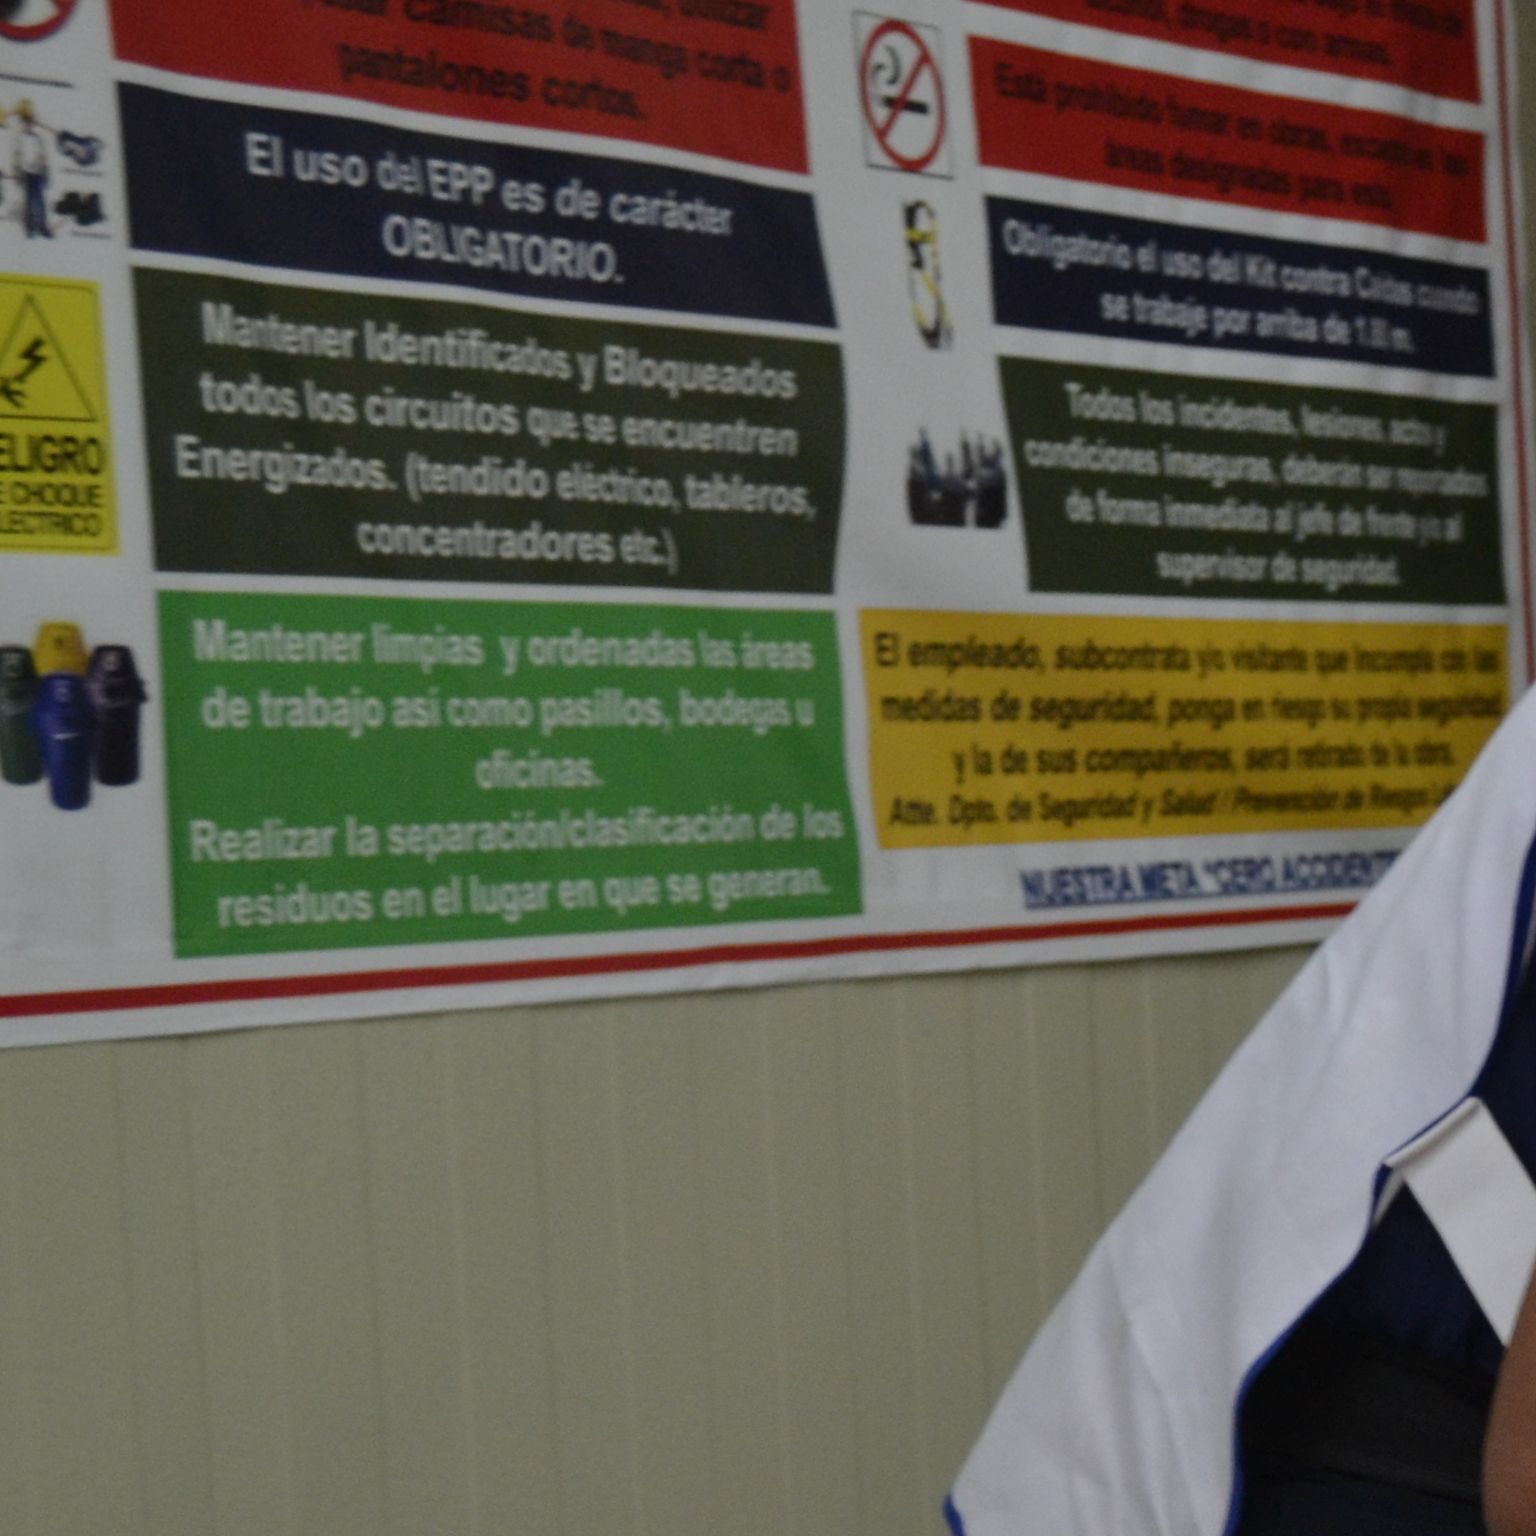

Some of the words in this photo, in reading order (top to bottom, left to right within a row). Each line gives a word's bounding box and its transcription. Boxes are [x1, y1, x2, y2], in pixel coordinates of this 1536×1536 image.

[336, 43, 531, 103] pantalones
[245, 131, 285, 178] El
[293, 149, 369, 188] uso
[376, 152, 425, 196] del
[426, 157, 496, 206] EPP
[501, 179, 547, 214] es
[554, 177, 600, 221] de
[608, 189, 735, 236] carácter
[381, 213, 626, 284] OBLIGATORIO.
[1001, 217, 1133, 270] Obligatorio
[201, 300, 357, 358] Mantener
[362, 319, 573, 381] Identificados
[577, 351, 599, 392] y
[603, 344, 799, 399] Bloqueados
[199, 371, 300, 419] todos
[304, 379, 358, 423] los
[363, 385, 521, 437] circuitos
[526, 405, 579, 447] que
[581, 411, 617, 445] se
[621, 417, 799, 456] encuentren
[1064, 381, 1137, 423] Todos
[0, 432, 106, 475] ELIGRO
[174, 433, 398, 495] Energizados.
[405, 451, 550, 503] (tendido
[683, 473, 818, 522] tableros,
[1022, 436, 1160, 477] condiciones
[356, 520, 616, 563] concentradores
[192, 618, 365, 664] Mantener
[370, 622, 485, 675] limpias
[499, 635, 520, 677] y
[527, 626, 697, 668] ordenadas
[698, 628, 738, 668] las
[740, 630, 816, 671] áreas
[875, 631, 899, 668] El
[907, 634, 1045, 677] empleado,
[202, 685, 251, 729] de
[257, 686, 385, 739] trabajo
[446, 696, 534, 728] como
[540, 687, 673, 736] pasillos,
[677, 687, 792, 736] bodegas
[990, 689, 1022, 723] de
[474, 747, 605, 790] oficinas.
[189, 817, 337, 864] Realizar
[346, 814, 380, 857] la
[758, 802, 798, 841] de
[802, 801, 846, 840] los
[216, 880, 375, 929] residuos
[381, 886, 427, 919] en
[431, 875, 465, 917] el
[468, 871, 551, 924] lugar
[557, 877, 599, 910] en
[603, 875, 660, 917] que
[664, 872, 703, 905] se
[706, 865, 832, 912] generan.
[1020, 863, 1133, 911] NUESTRA
[1136, 858, 1197, 904] META
